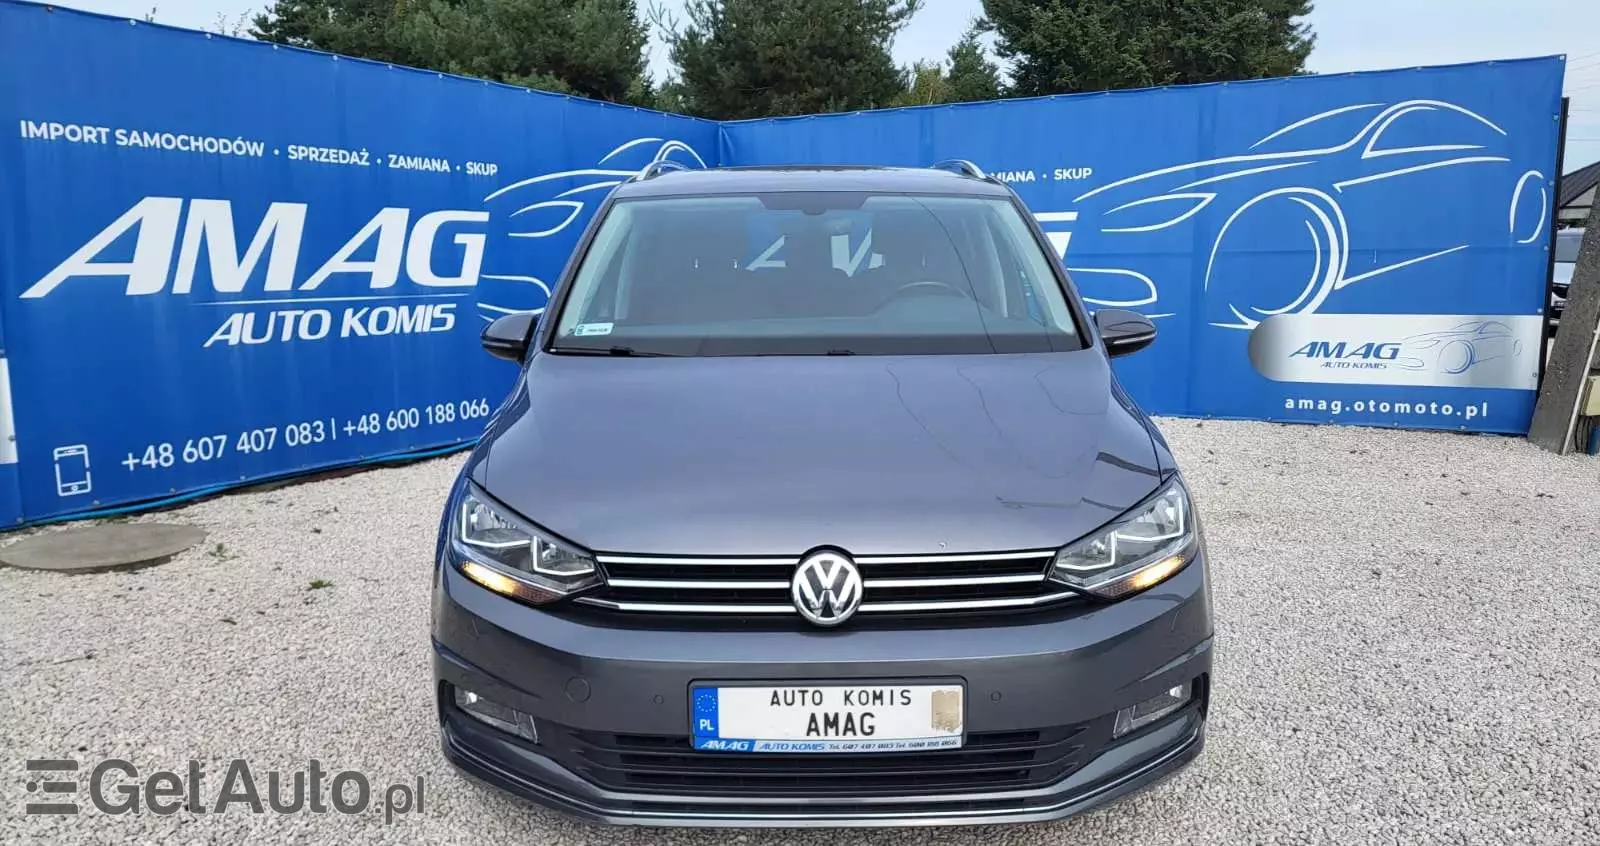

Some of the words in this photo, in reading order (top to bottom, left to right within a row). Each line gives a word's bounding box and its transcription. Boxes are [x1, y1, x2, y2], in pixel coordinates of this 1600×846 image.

[20, 120, 110, 145] IMPORT
[115, 128, 265, 158] SAMOCHODÓW
[287, 145, 371, 167] SPRZEDAŻ
[388, 154, 451, 173] ZAMIANA
[465, 161, 498, 177] SKUP
[1053, 167, 1093, 180] SKUP
[19, 196, 490, 299] AMAG
[203, 309, 331, 348] AUTO
[340, 303, 457, 339] KOMIS
[1288, 341, 1402, 360] AMAG
[1285, 398, 1488, 419] amag.otomoto.pl
[121, 443, 174, 472] +48
[182, 435, 228, 463] 607
[236, 426, 277, 454] 407
[284, 419, 326, 444] 083
[342, 411, 381, 438] +48
[386, 406, 420, 431] 600
[426, 402, 456, 423] 188
[459, 397, 490, 419] 066
[770, 690, 823, 706] AUTO
[844, 689, 912, 706] KOMIS
[700, 719, 714, 731] PL
[806, 712, 876, 737] AMAG
[700, 740, 750, 751] AMAG
[760, 743, 790, 751] AUTO
[791, 743, 825, 751] KOMIS
